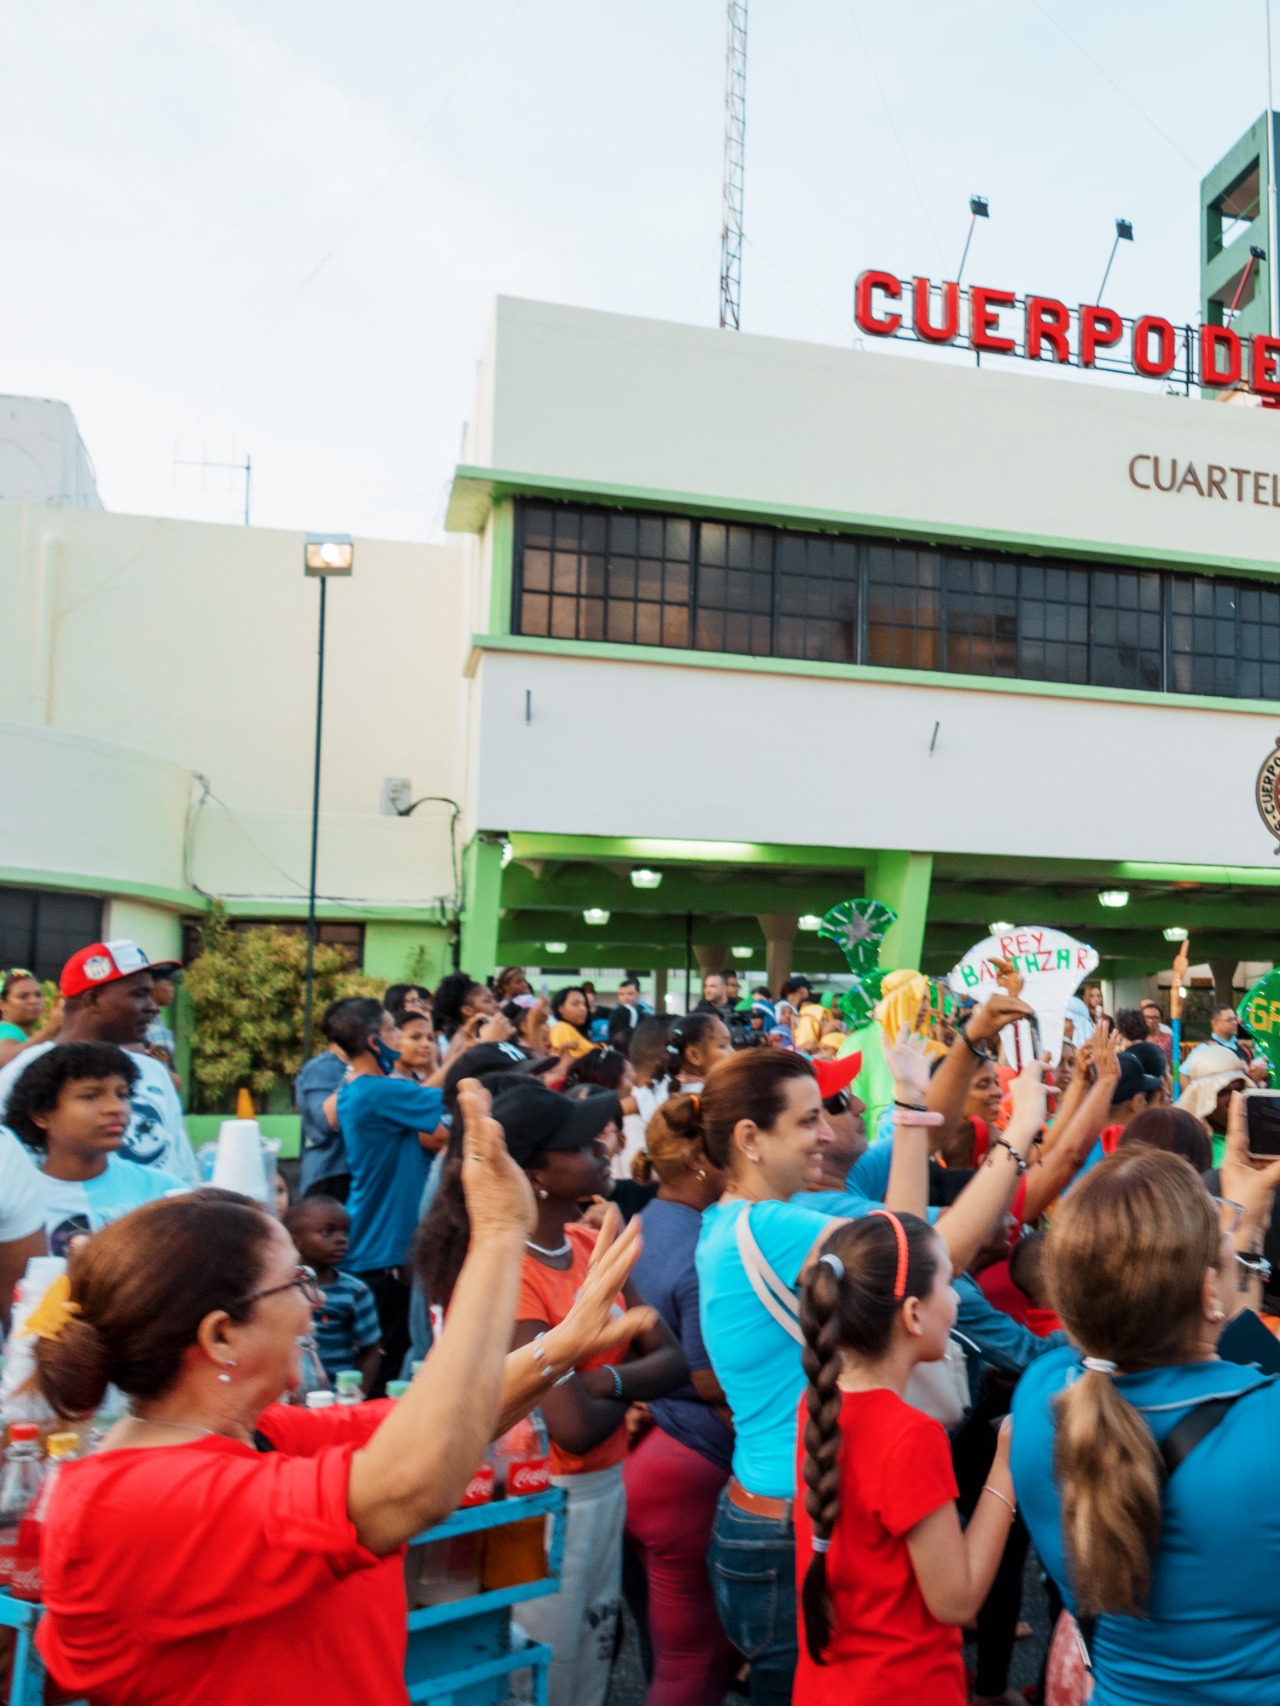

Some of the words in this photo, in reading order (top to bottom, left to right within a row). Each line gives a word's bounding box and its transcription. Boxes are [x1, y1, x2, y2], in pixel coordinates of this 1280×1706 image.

[854, 269, 1175, 379] CUERPO
[999, 931, 1044, 958] REY
[960, 948, 1089, 988] BATHZAR
